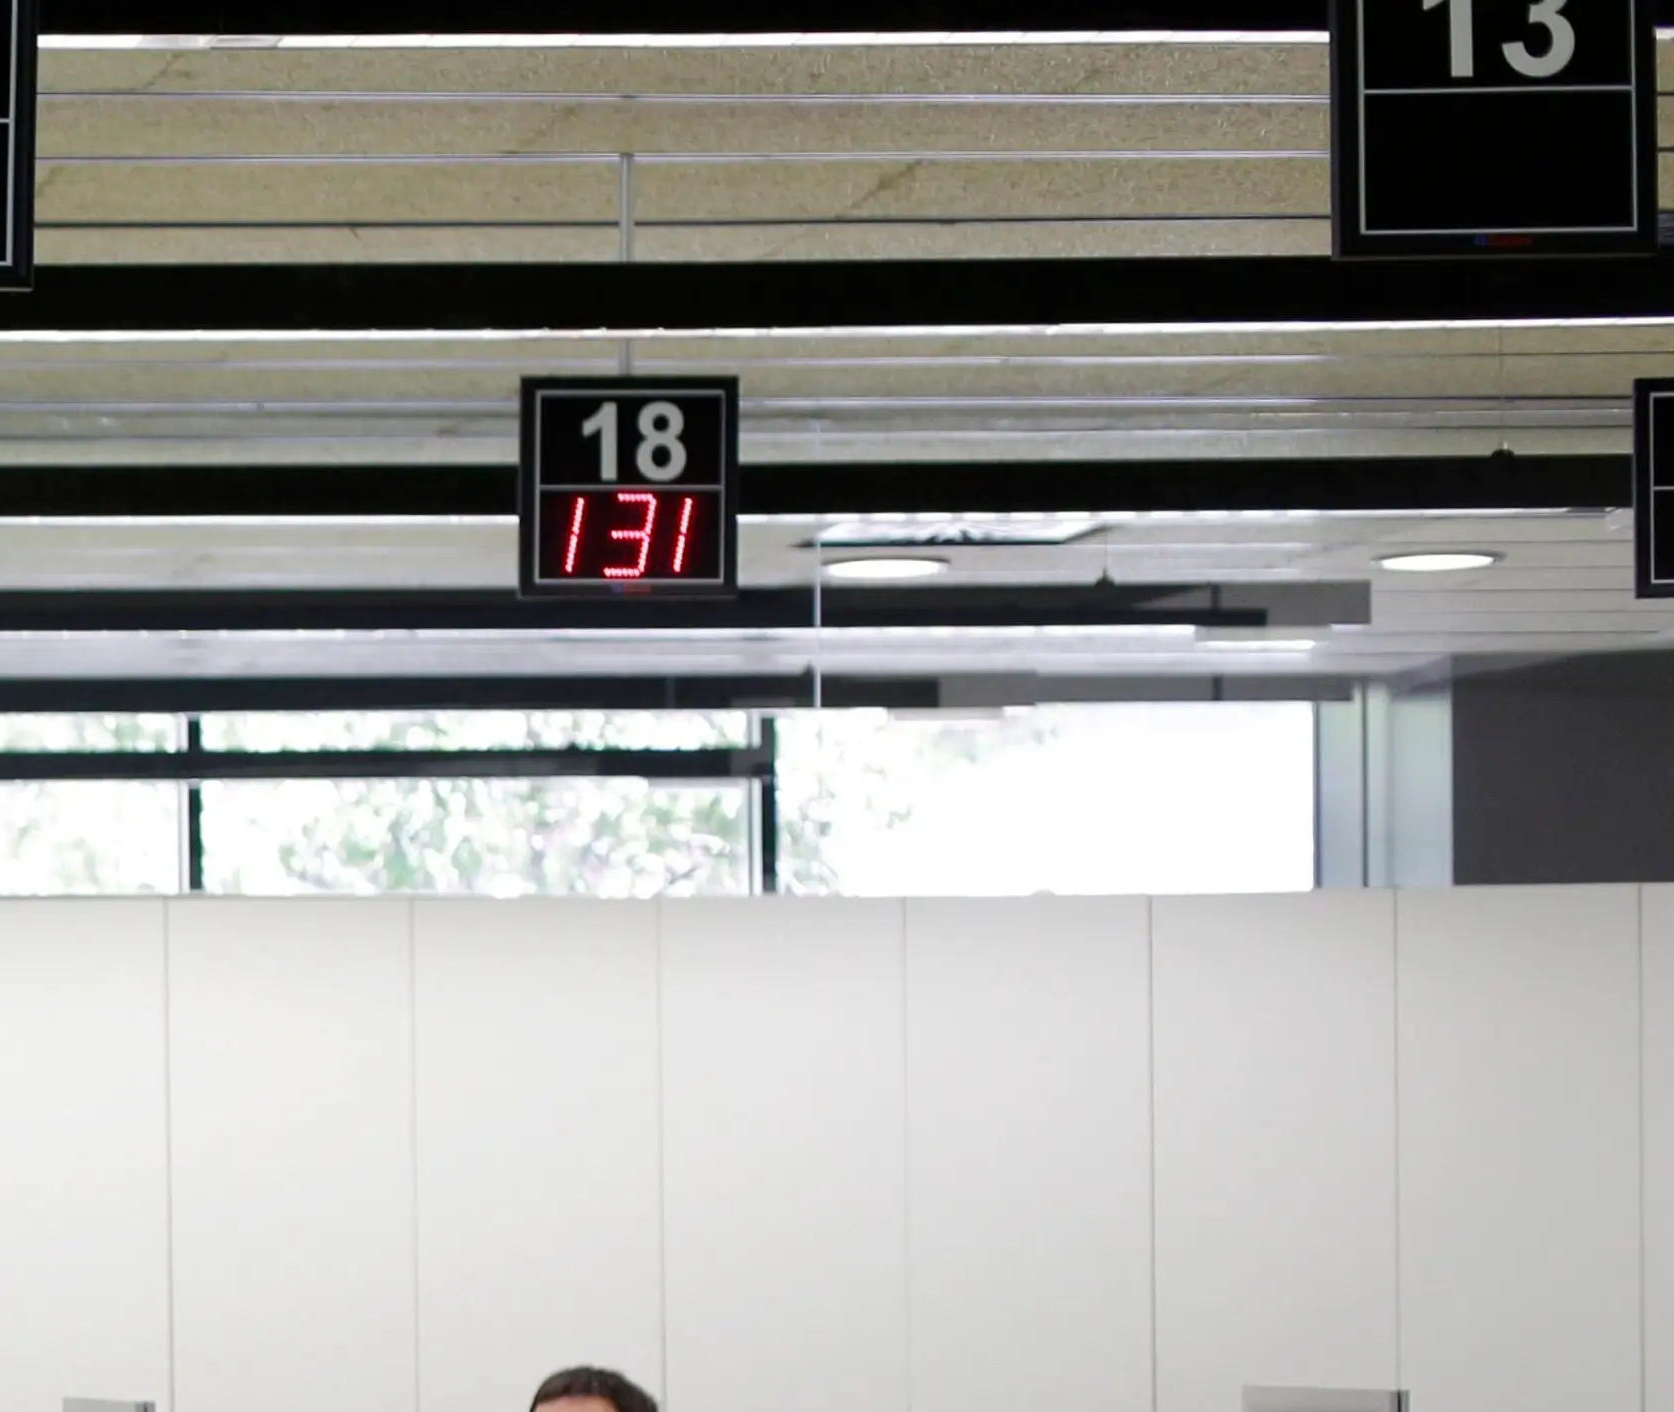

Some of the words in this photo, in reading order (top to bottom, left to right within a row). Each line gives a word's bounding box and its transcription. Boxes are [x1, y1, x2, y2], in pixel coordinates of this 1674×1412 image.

[1422, 0, 1575, 77] 13
[581, 400, 688, 482] 18
[564, 492, 694, 578] 131
